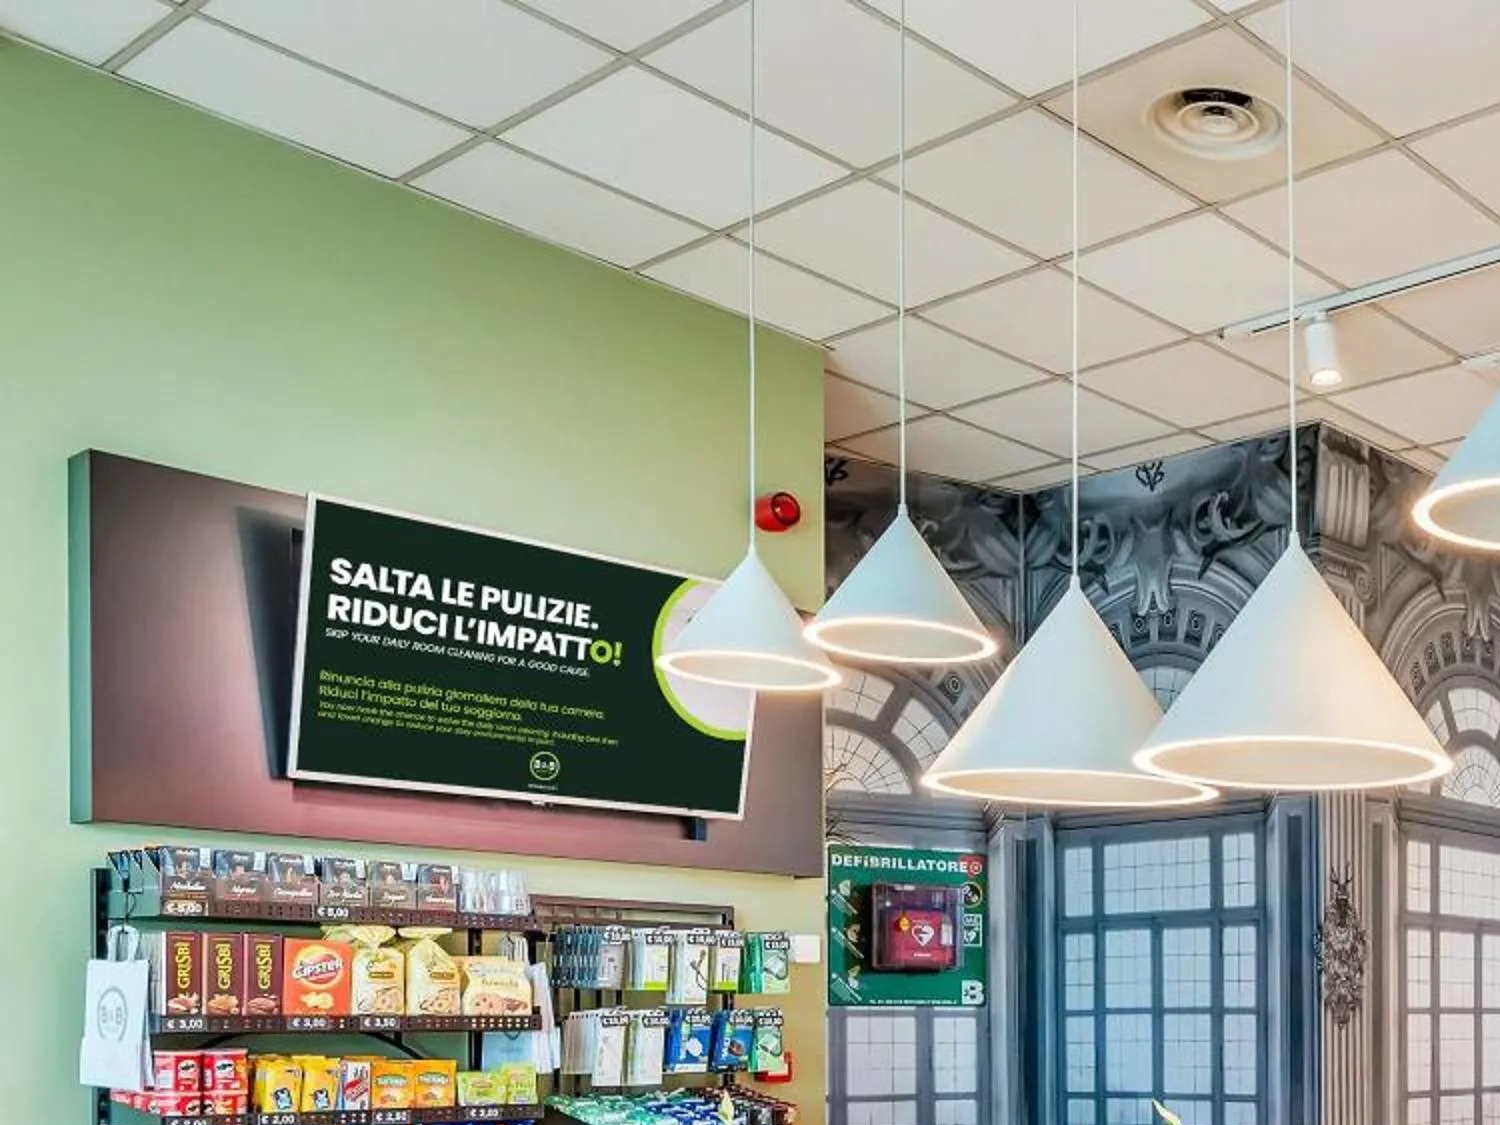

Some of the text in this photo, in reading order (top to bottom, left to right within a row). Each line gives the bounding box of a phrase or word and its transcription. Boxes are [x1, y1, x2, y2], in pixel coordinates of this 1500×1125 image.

[329, 557, 599, 630] SALTA LE PULIZIE.
[325, 627, 349, 639] SKIP
[351, 631, 381, 645] YOUR
[382, 637, 411, 649] DAILY
[412, 641, 445, 655] ROOM
[447, 647, 495, 663] CLEANING
[497, 655, 517, 666] FOR
[518, 658, 527, 667] A
[527, 658, 558, 673] GOOD
[327, 593, 623, 667] RIDUCI L'IMPATTO!
[319, 669, 376, 689] Rinuncia
[319, 684, 359, 700] Riduci
[420, 698, 439, 711] del
[441, 702, 461, 714] tuo
